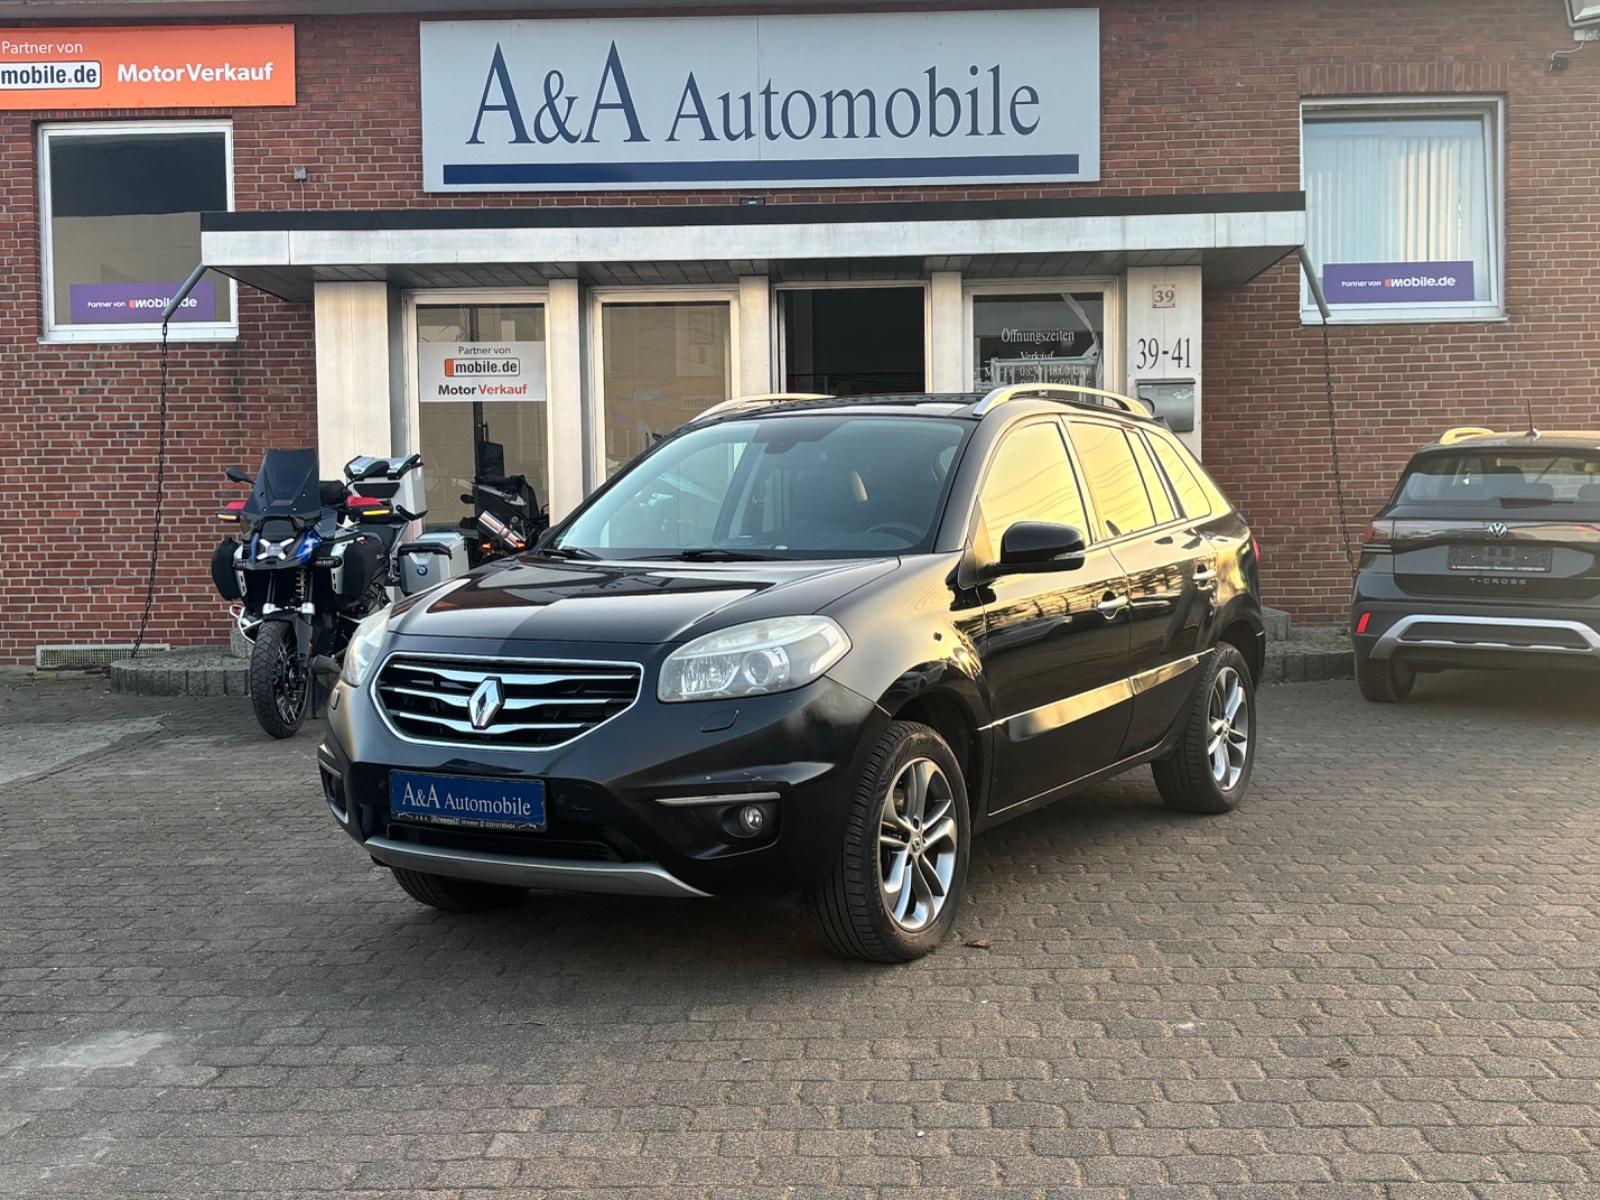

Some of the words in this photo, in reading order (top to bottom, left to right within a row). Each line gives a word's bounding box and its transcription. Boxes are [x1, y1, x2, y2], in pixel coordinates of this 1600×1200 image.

[2, 41, 54, 54] Partner
[57, 42, 83, 54] von
[1, 65, 97, 85] mobile.de
[465, 40, 651, 145] A&A
[665, 64, 1041, 142] Automobile
[1392, 276, 1456, 287] mobile.de
[1154, 289, 1175, 303] 39
[136, 298, 197, 308] mobil.de
[1001, 328, 1074, 344] Öffnungszeiten
[458, 346, 491, 354] Partner
[455, 361, 517, 373] mobile.de
[438, 385, 476, 395] Motor
[478, 384, 528, 395] Verkauf
[402, 781, 440, 809] A&A
[444, 792, 531, 816] Automobile
